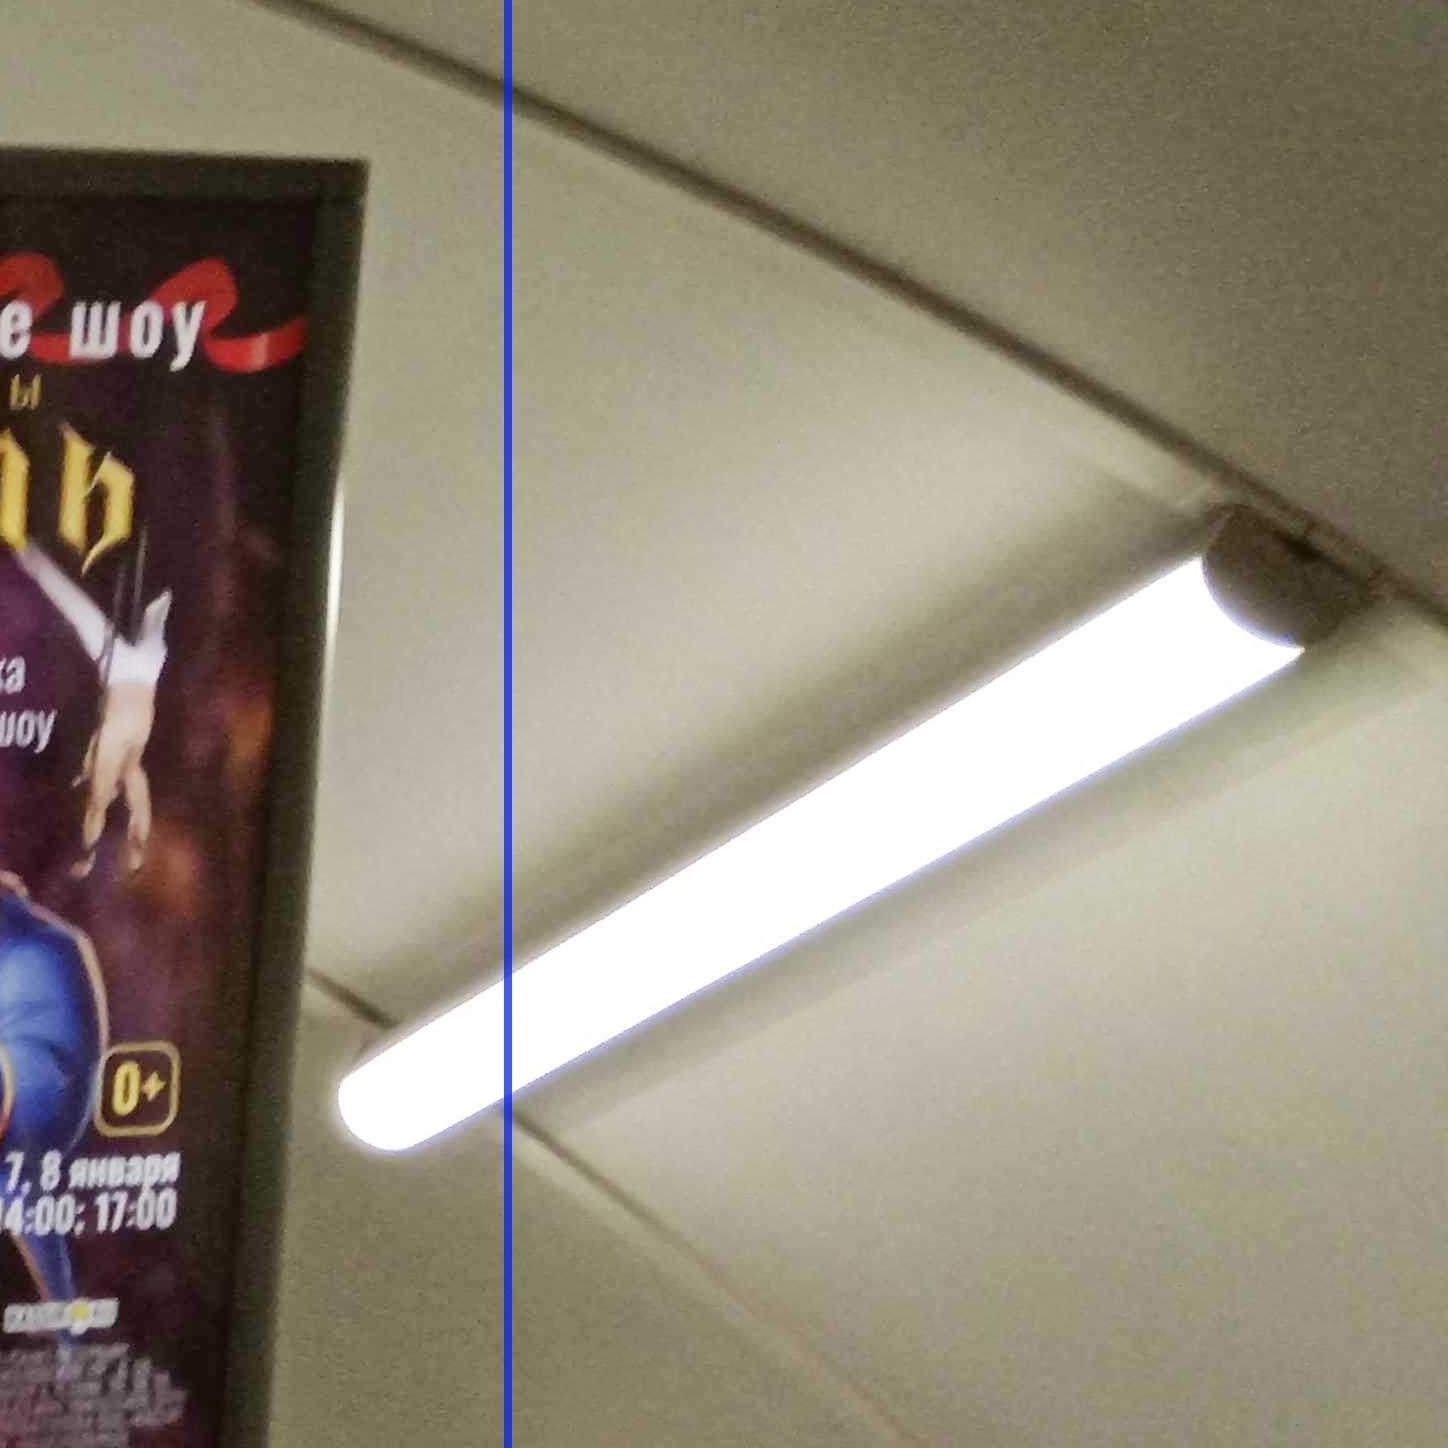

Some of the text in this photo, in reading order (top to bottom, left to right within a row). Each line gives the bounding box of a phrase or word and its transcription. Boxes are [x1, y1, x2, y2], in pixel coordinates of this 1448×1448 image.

[68, 298, 208, 372] шоу
[111, 1059, 167, 1117] 0+
[40, 1149, 62, 1192] 8
[68, 1151, 181, 1193] января
[95, 1187, 178, 1233] 17:00
